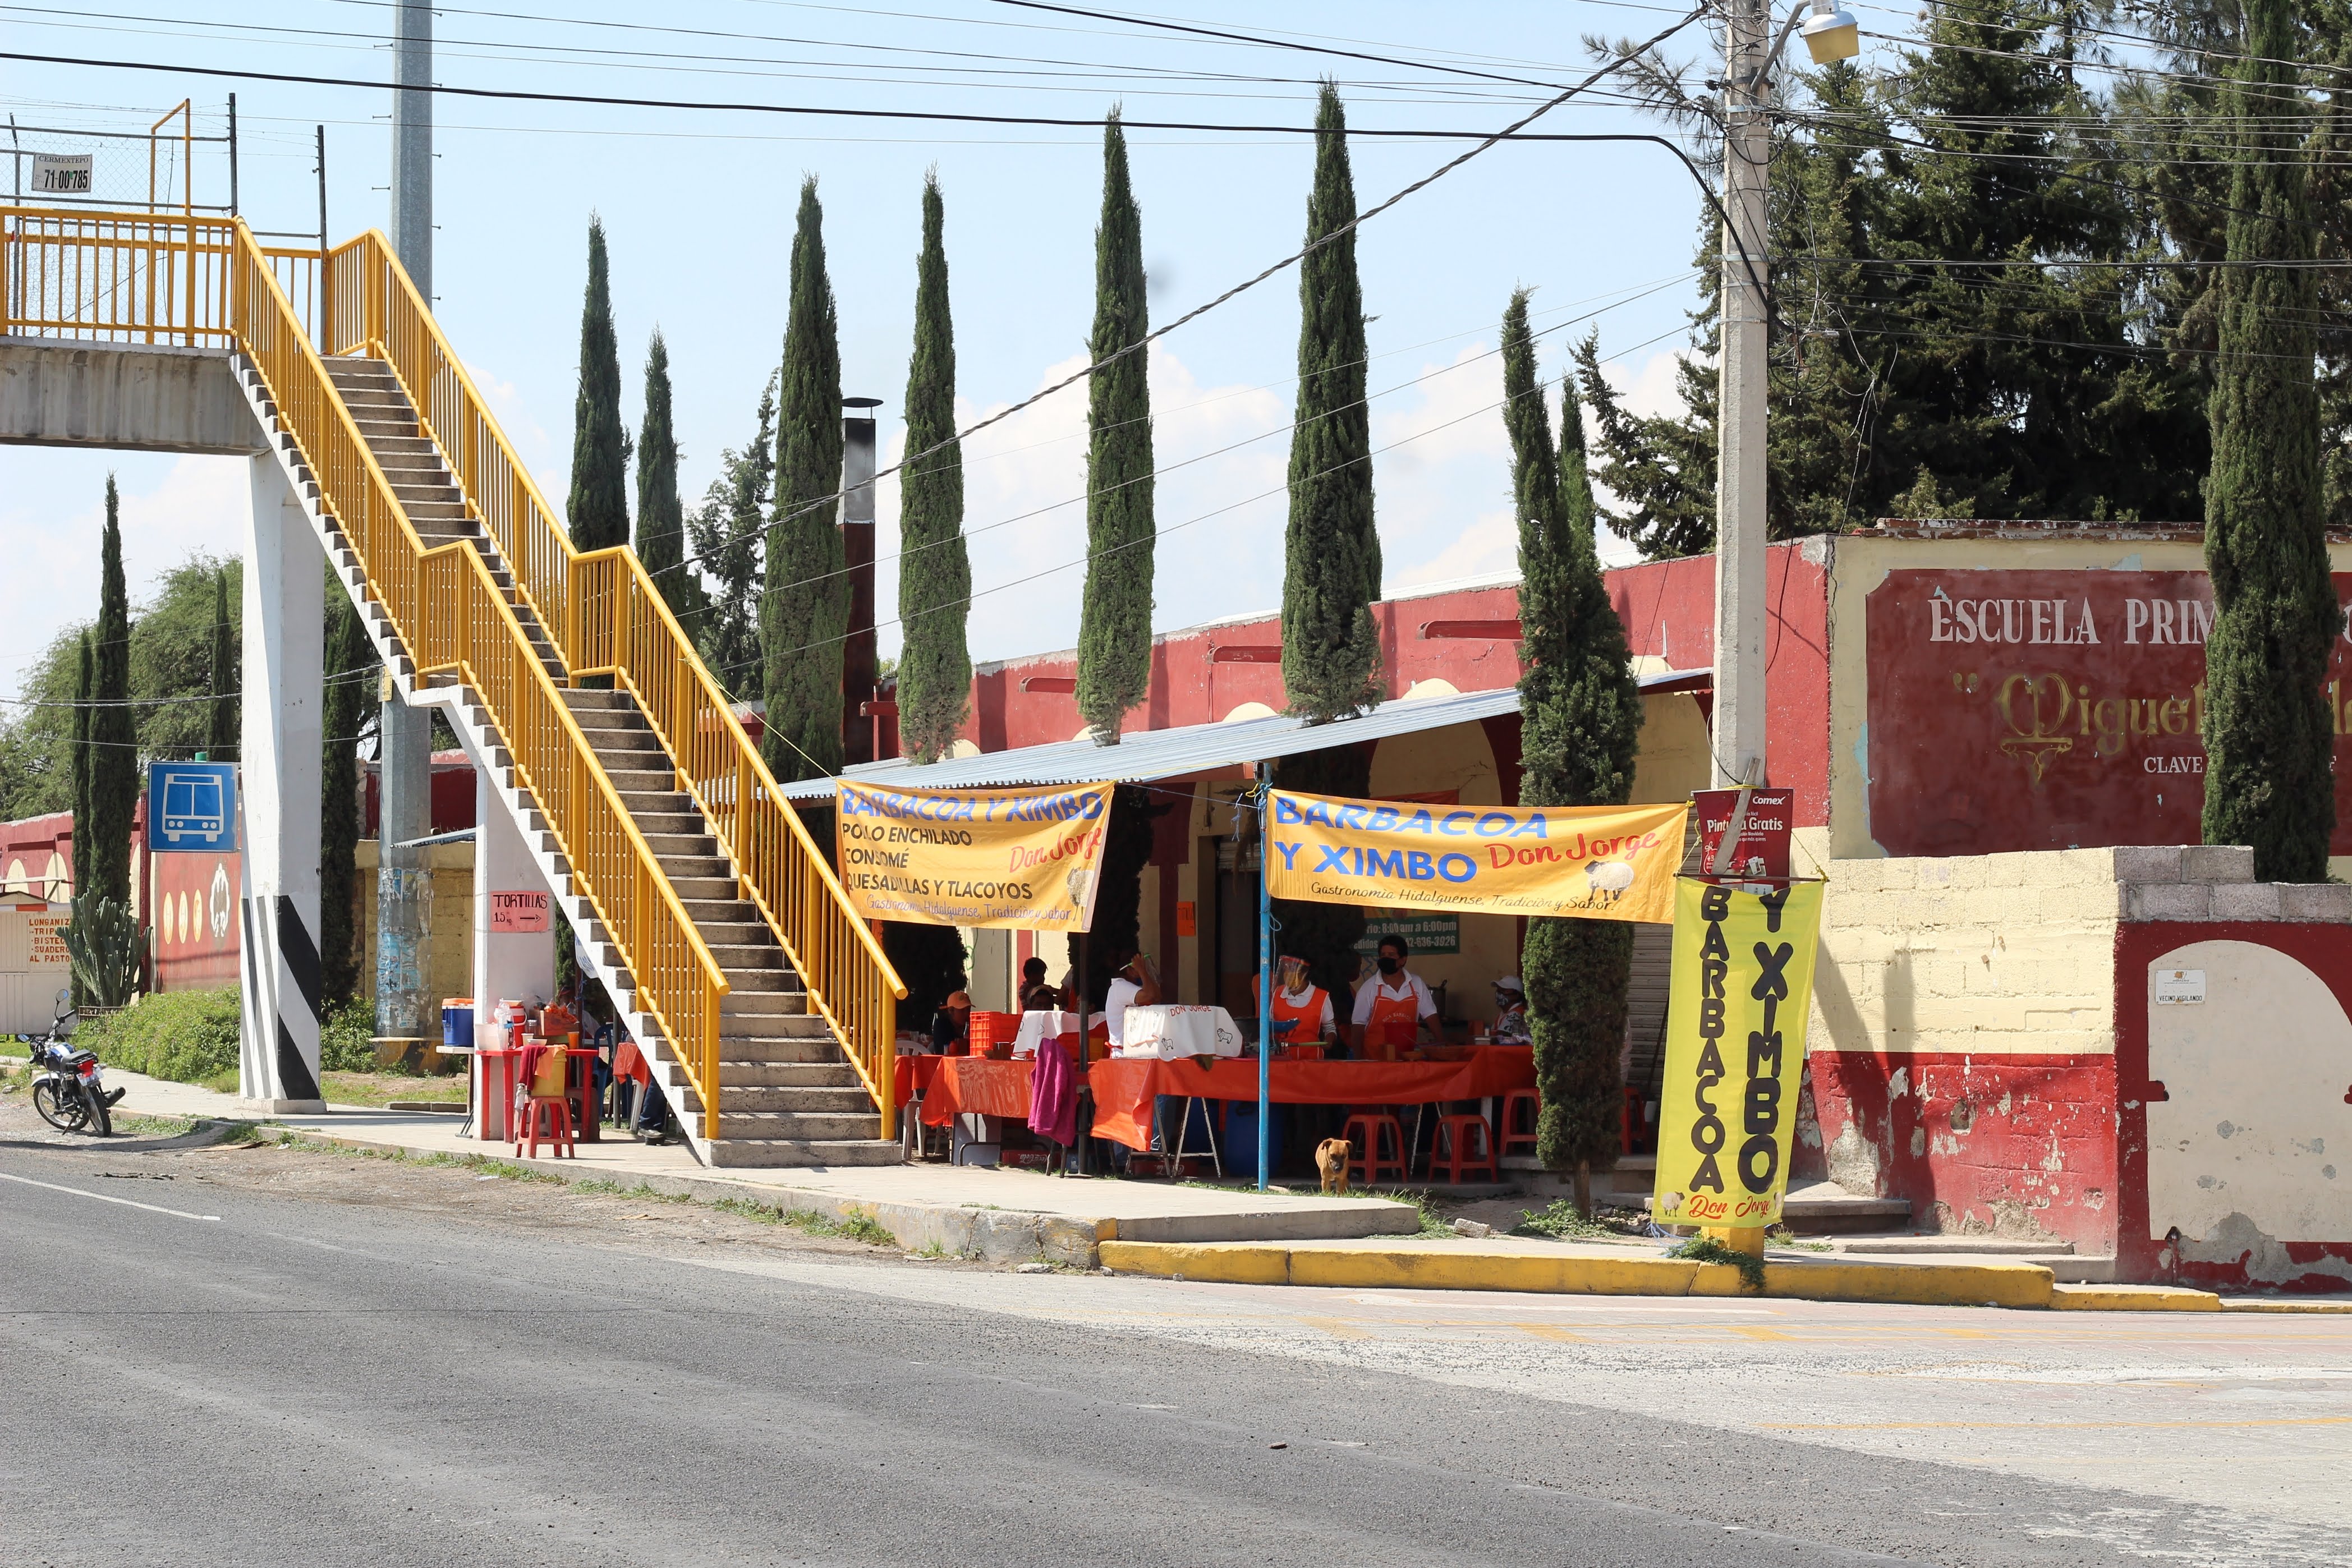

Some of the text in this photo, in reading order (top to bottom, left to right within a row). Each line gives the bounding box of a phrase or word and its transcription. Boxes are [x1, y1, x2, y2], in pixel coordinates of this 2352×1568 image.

[39, 155, 89, 164] CERMEXTEPO
[1927, 597, 2217, 645] ESCUELA PRIM
[2144, 756, 2203, 774] CLAVE
[841, 788, 1104, 822] BARBACOA Y XIMBO
[1752, 796, 1786, 806] Comex
[1275, 796, 1549, 839] BARBACOA
[1707, 817, 1783, 833] Pinta Gratis
[888, 826, 972, 846] ENCHILADO
[845, 847, 909, 868] CONSOMÉ
[1009, 827, 1102, 873] Don Jorge
[1274, 833, 1661, 882] Y XIMBO Don Jorge
[934, 880, 944, 896] Y
[948, 880, 1033, 900] TLACOYOS
[493, 894, 548, 909] TORTILLAS
[1553, 901, 1563, 912] y
[1400, 924, 1413, 933] am
[1415, 923, 1421, 932] a
[1353, 939, 1378, 949] edidos
[1170, 1005, 1186, 1017] DON
[1689, 885, 1732, 1194] BARBACOA
[1737, 887, 1794, 1194] Y XIMBO
[1688, 1194, 1771, 1220] Don Jorge
